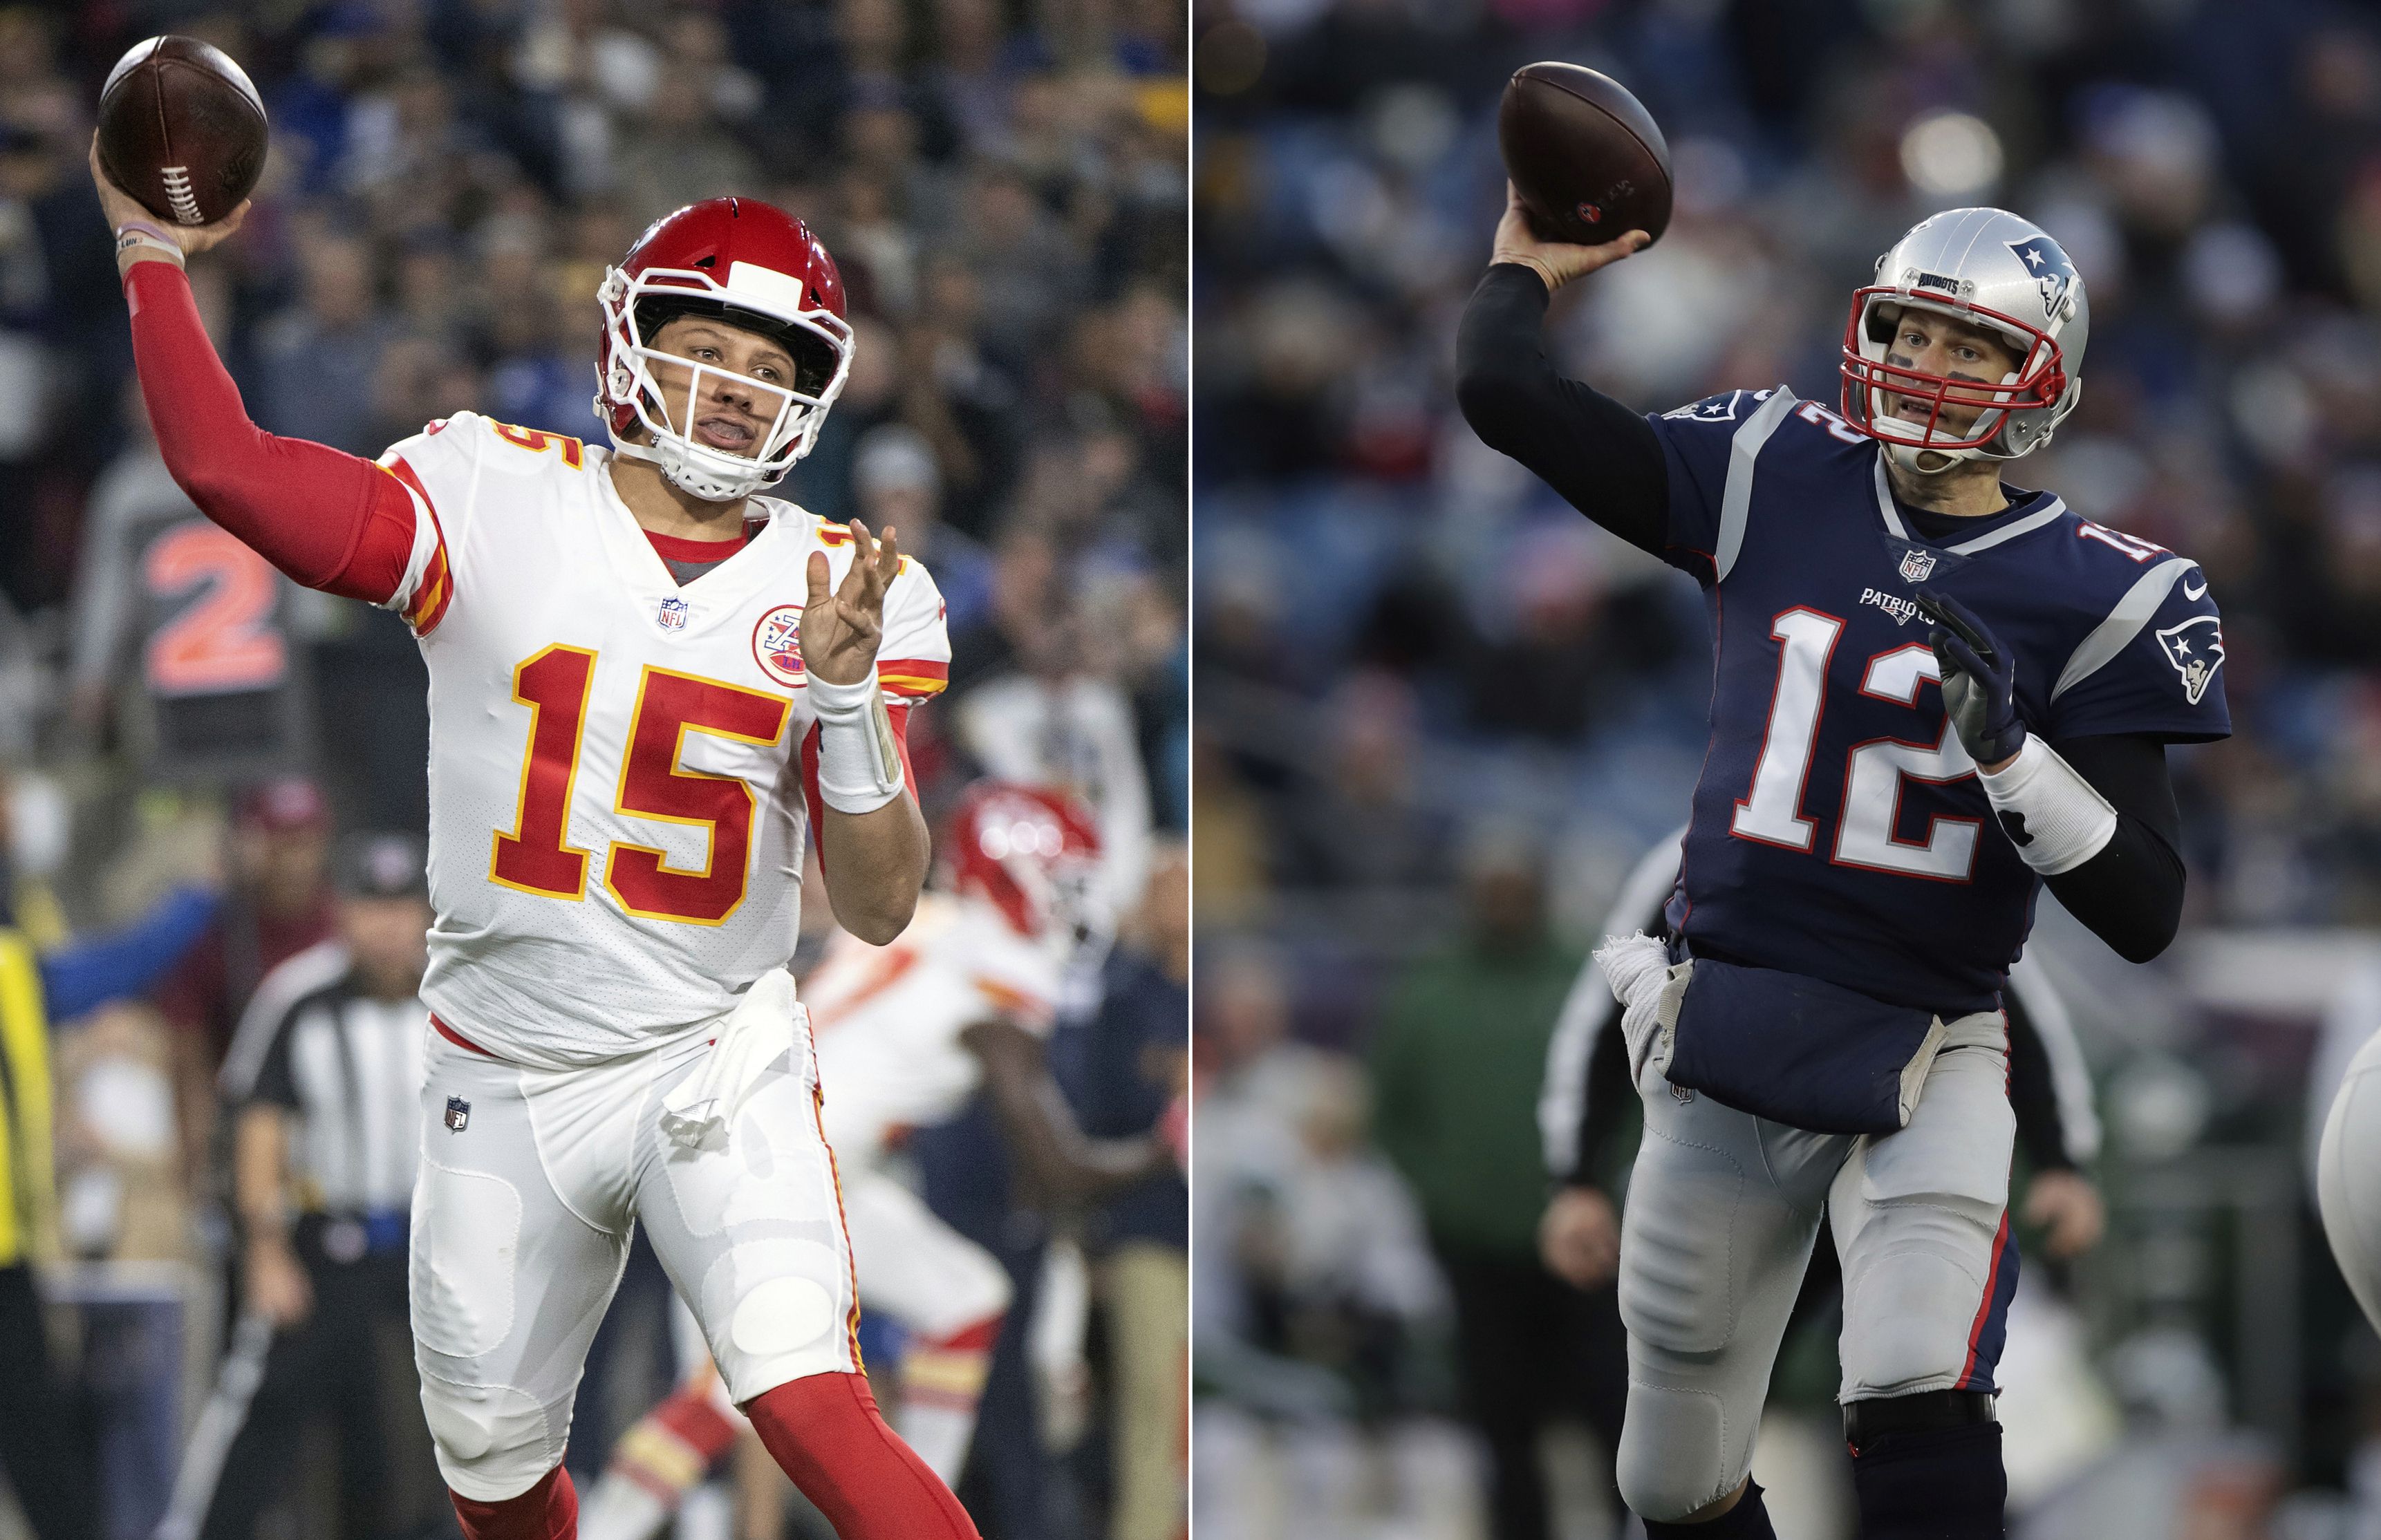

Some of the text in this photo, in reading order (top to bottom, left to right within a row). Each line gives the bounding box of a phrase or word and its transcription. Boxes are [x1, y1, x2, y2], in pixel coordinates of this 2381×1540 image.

[1918, 273, 1959, 294] PATRIOTS
[1905, 562, 1926, 577] NFL
[144, 523, 286, 694] 2
[661, 610, 682, 626] NFL
[1729, 604, 1984, 885] 12
[488, 642, 794, 927] 15
[447, 1109, 464, 1127] NFL
